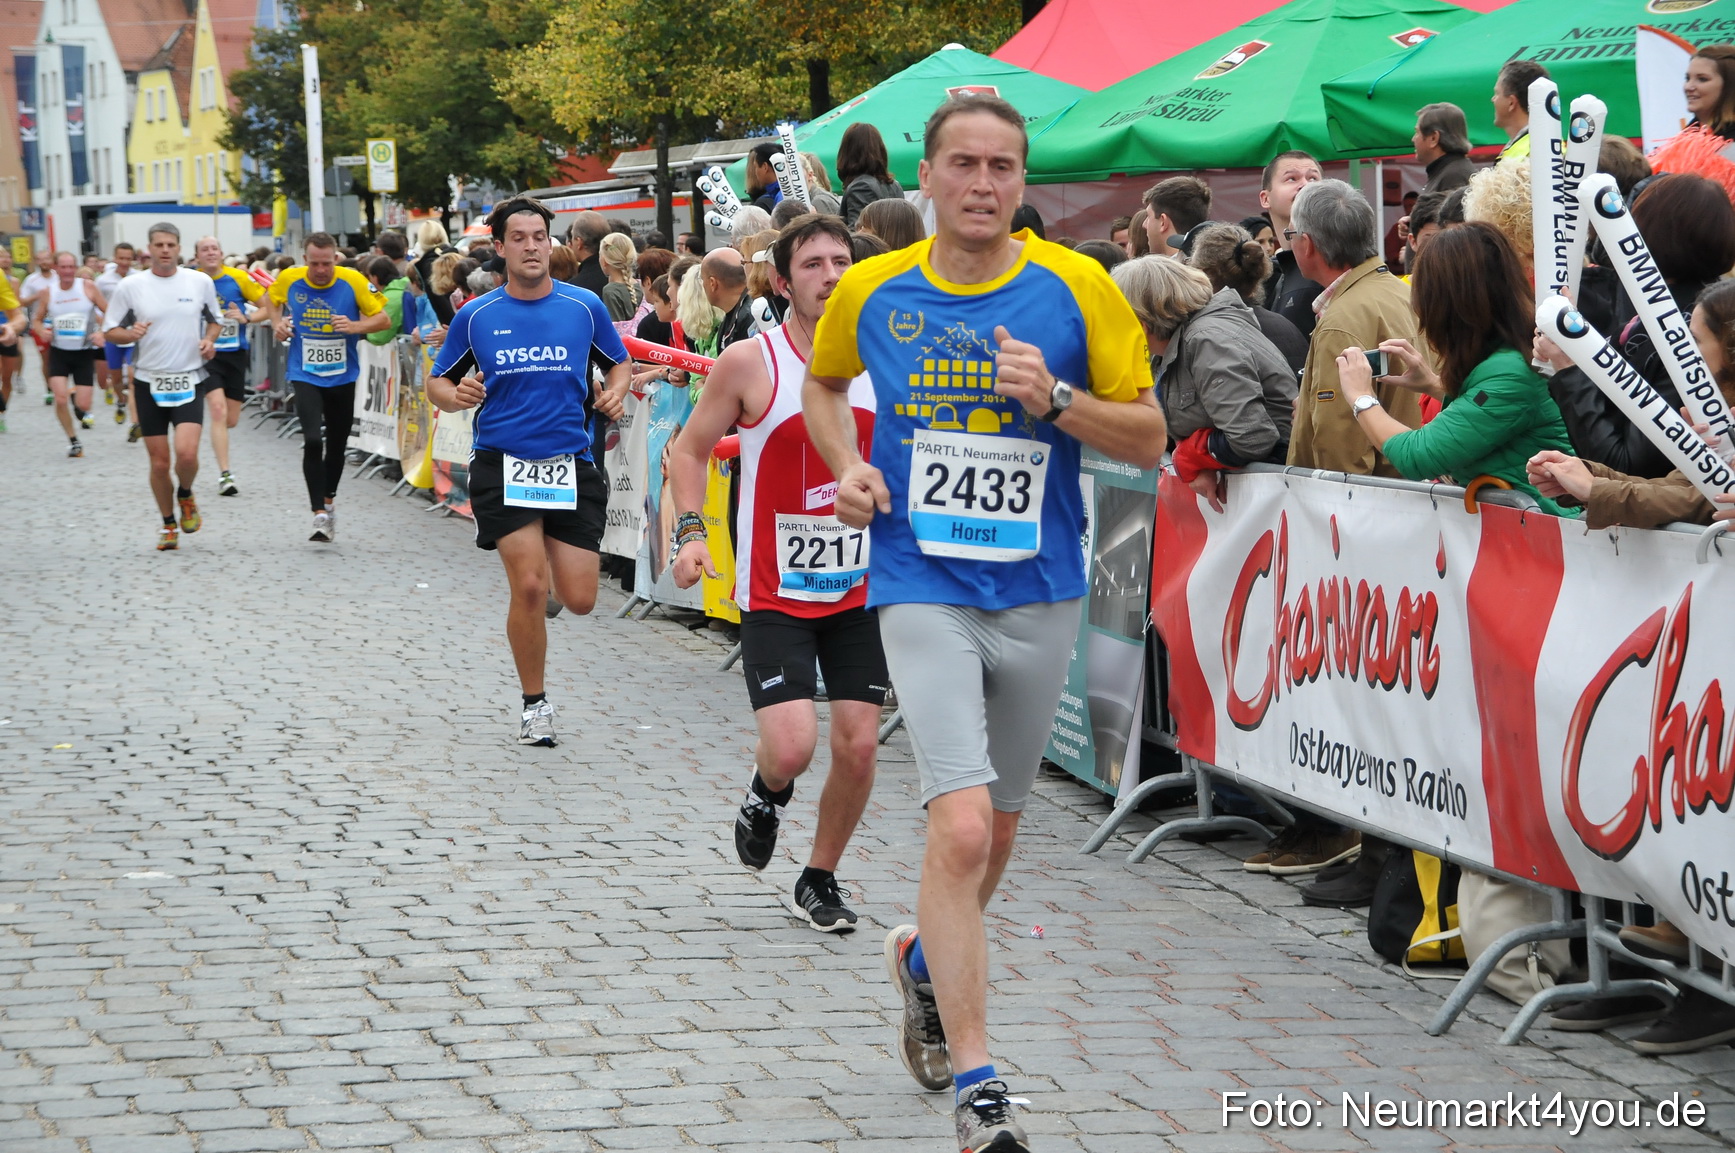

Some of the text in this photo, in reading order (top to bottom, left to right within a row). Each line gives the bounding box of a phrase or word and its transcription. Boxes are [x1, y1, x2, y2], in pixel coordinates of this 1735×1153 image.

[782, 133, 806, 204] Laufsport MW
[1618, 232, 1672, 305] BMW
[902, 313, 912, 321] 15
[895, 322, 917, 330] Jahre
[307, 348, 342, 363] 2865
[495, 346, 568, 366] SYSCAD
[495, 365, 572, 376] www.metallbau-cad.de
[681, 358, 702, 371] BKK
[155, 376, 190, 391] 2566
[1592, 344, 1660, 410] BMW
[910, 392, 1007, 404] 21.September 2014
[916, 442, 1026, 463] PARTL Neumarkt
[512, 460, 569, 487] 2432
[524, 490, 556, 500] Fabian
[821, 487, 839, 501] DEH
[923, 462, 1033, 514] 2433
[778, 523, 810, 532] PARTL
[951, 522, 998, 542] Horst
[788, 532, 863, 569] 2217
[804, 575, 853, 590] Michael
[1222, 509, 1447, 731] Charivari
[1290, 721, 1467, 821] Ostbayerns Radio
